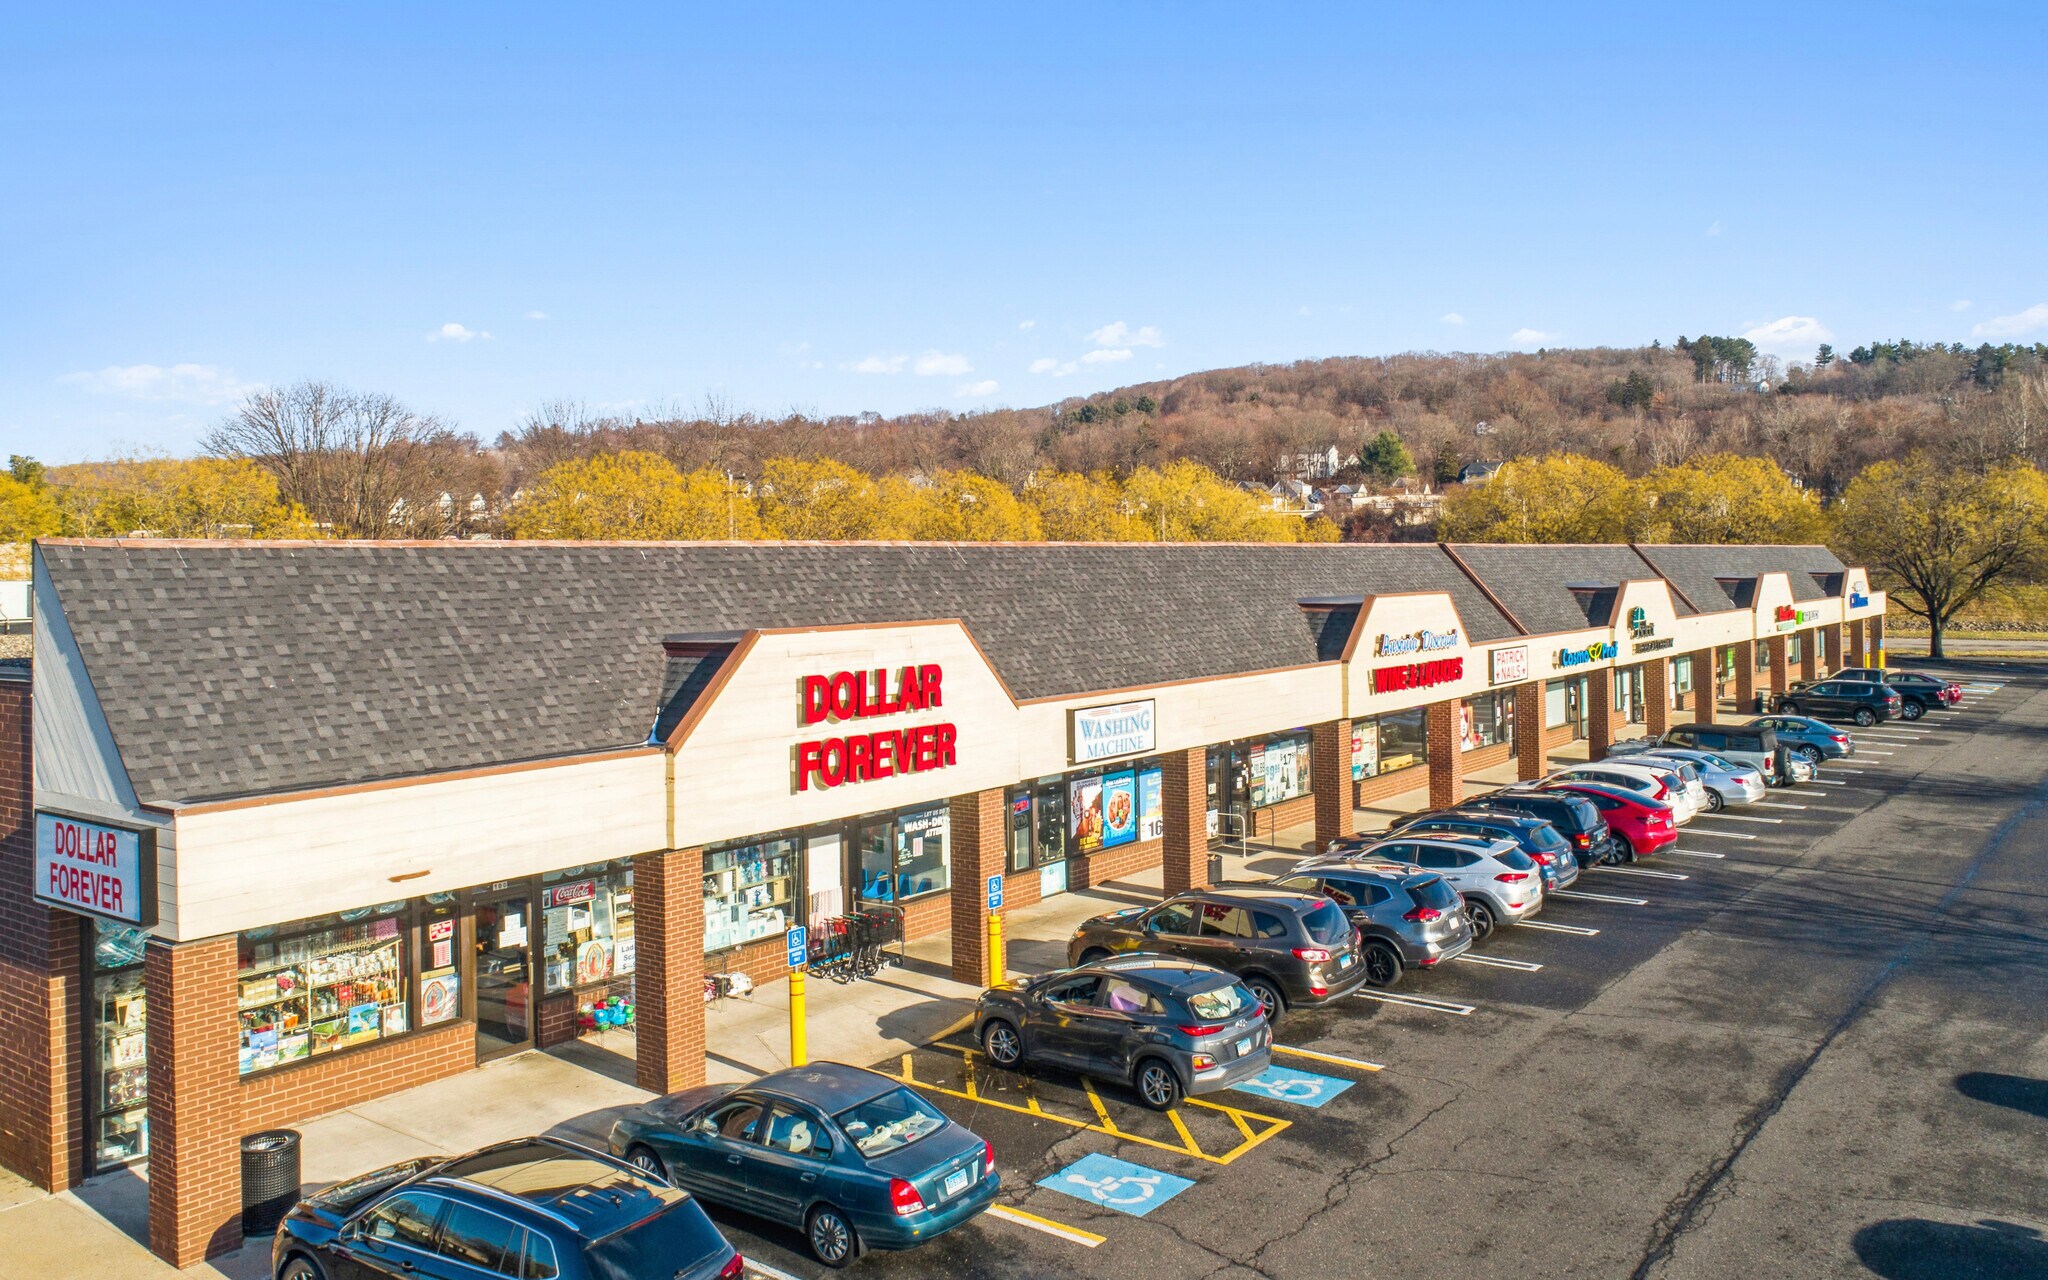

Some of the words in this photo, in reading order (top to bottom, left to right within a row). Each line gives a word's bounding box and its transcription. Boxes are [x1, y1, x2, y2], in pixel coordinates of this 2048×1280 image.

[1496, 650, 1525, 666] PATRICK
[1562, 648, 1590, 668] Cosmo
[1601, 640, 1619, 660] Prof
[1375, 665, 1408, 694] WINE
[1408, 664, 1417, 689] &
[1418, 657, 1463, 688] LIQUORS
[1501, 664, 1521, 681] NAILS
[804, 664, 943, 725] DOLLAR
[1080, 710, 1150, 742] WASHING
[798, 723, 957, 791] FOREVER
[1086, 736, 1145, 759] MACHINE
[56, 822, 117, 868] DOLLAR
[50, 862, 123, 913] FOREVER
